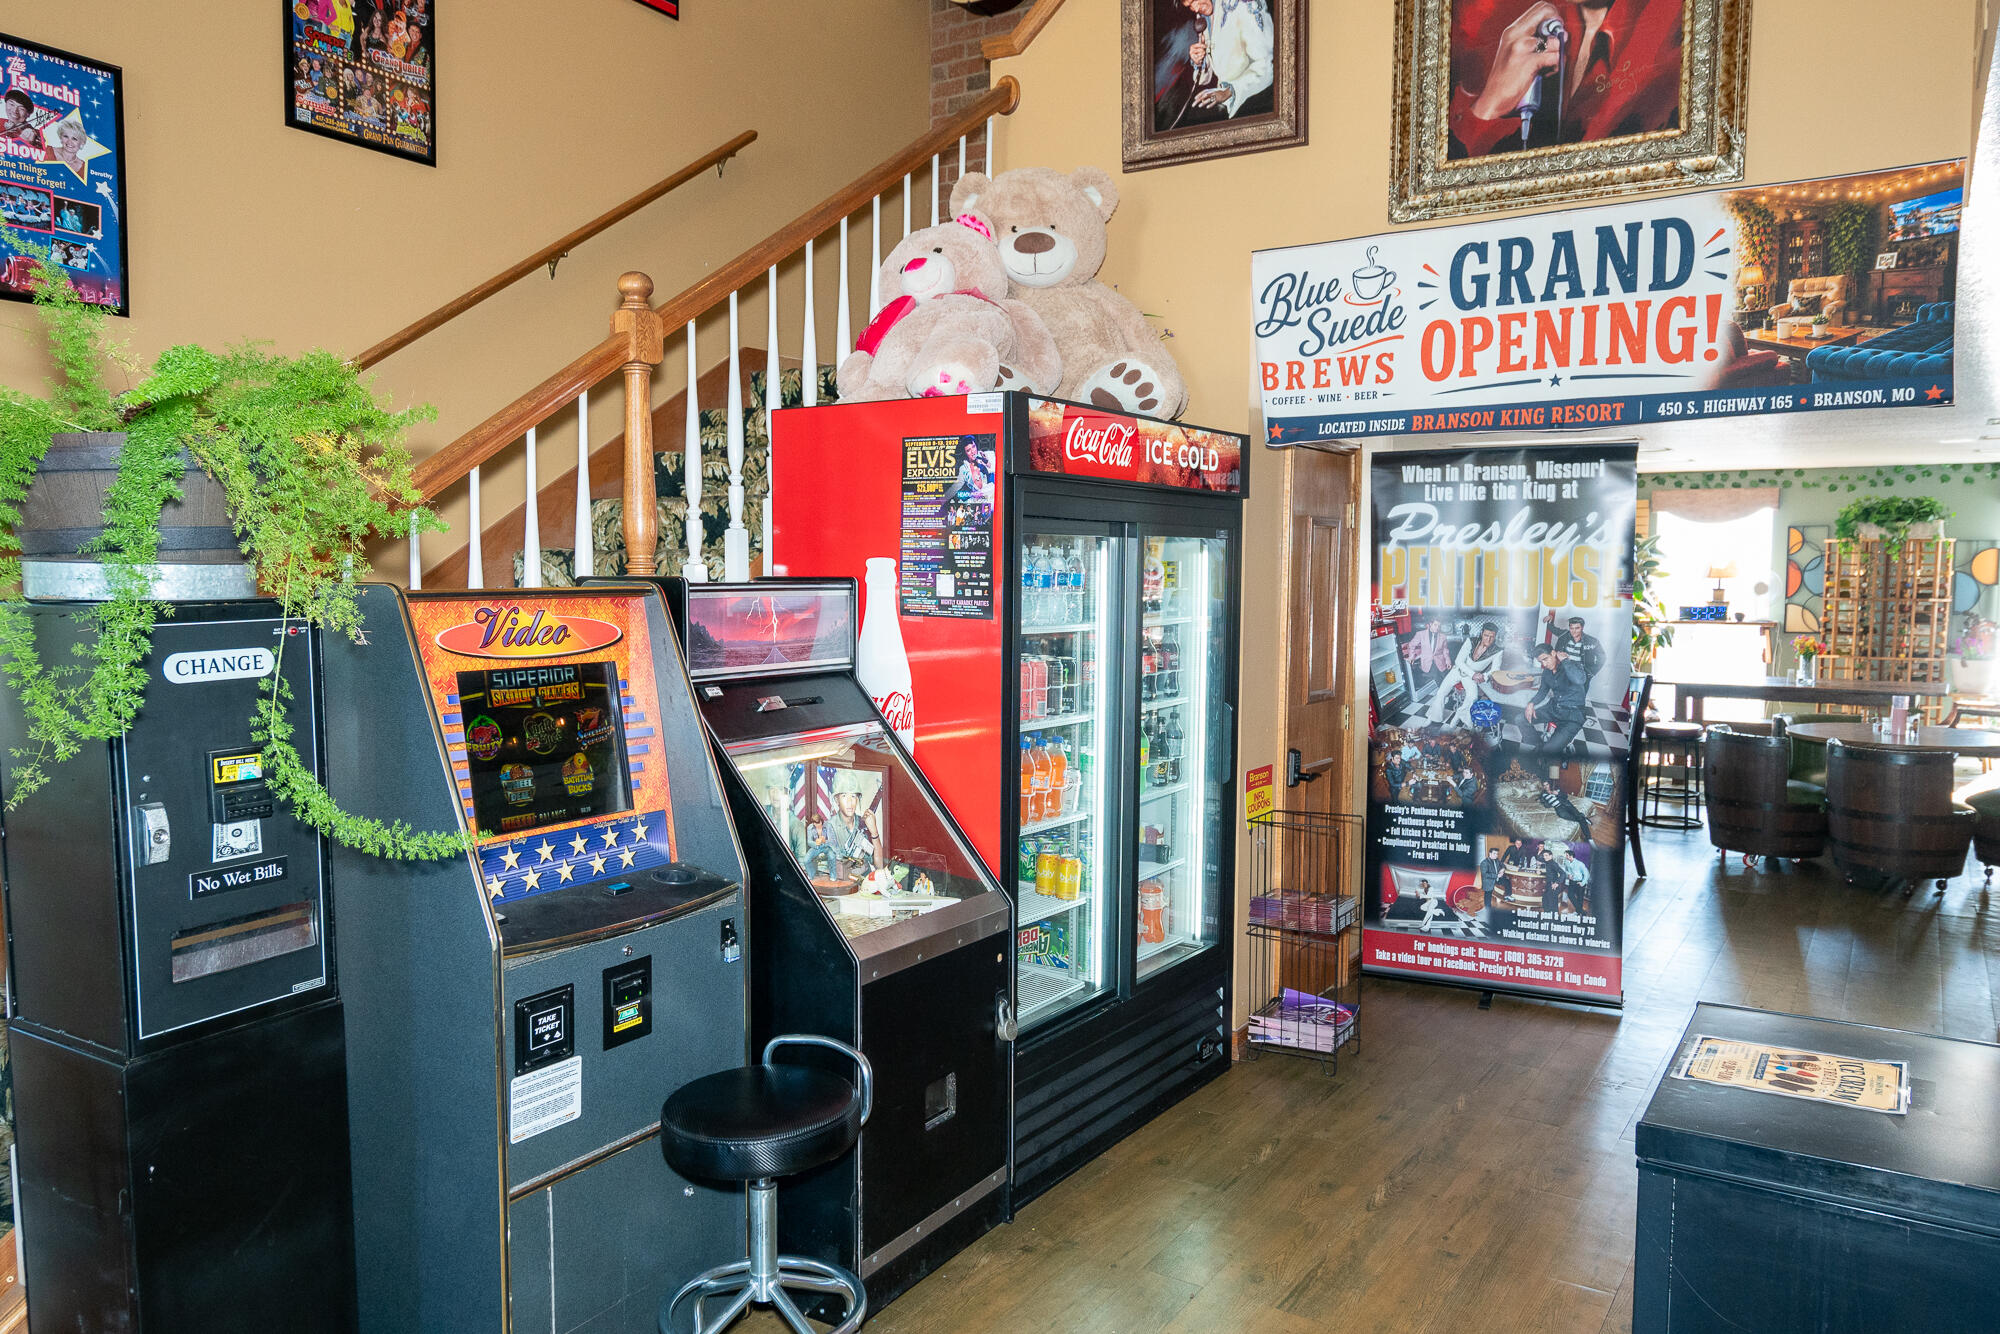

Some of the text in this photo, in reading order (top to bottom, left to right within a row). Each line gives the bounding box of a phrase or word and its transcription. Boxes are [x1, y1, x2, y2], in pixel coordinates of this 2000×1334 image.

[23, 50, 39, 59] FOR
[43, 55, 65, 66] OVER
[68, 61, 79, 70] 26
[397, 60, 426, 76] JUBILEE
[6, 70, 80, 107] Tabuchi
[0, 136, 46, 162] Show
[382, 132, 395, 146] FUN
[0, 159, 48, 176] ome Things
[89, 169, 113, 180] Dorothy
[9, 169, 35, 183] Never
[36, 174, 66, 190] Forget!
[1450, 217, 1695, 311] GRAND
[1256, 271, 1342, 338] Blue
[1299, 294, 1407, 357] Suede
[1420, 294, 1722, 382] OPENING!
[1261, 352, 1394, 391] BREWS
[1272, 391, 1378, 406] COFFEE WINE BEER
[1318, 387, 1916, 435] LOCATED INSIDE BRANSON KING RESORT 450 S. HIGHWAY 165 BRANSON, MO
[1065, 416, 1136, 467] Coca-Cola
[907, 449, 956, 468] ELVIS
[1145, 438, 1219, 471] ICE COLD
[907, 467, 956, 478] EXPLOSION
[1402, 458, 1606, 483] When in Branson, Missouri
[1424, 480, 1578, 502] Live like the King at
[1386, 502, 1618, 565] Presley's
[1381, 545, 1625, 609] PENTHOUSE
[474, 606, 570, 649] Video
[175, 654, 264, 676] CHANGE
[492, 667, 575, 688] SUPERIOR
[492, 683, 579, 706] SKILL GAMES
[1249, 770, 1270, 783] Branson
[567, 783, 593, 795] BUCKS
[1253, 790, 1265, 802] INFO
[1247, 797, 1271, 815] COUPONS
[1384, 804, 1464, 819] Presley's Penthouse features:
[1397, 816, 1425, 827] Penthouse
[1426, 818, 1444, 829] sleeps
[1390, 826, 1401, 836] Full
[1401, 827, 1421, 837] kitchen
[1427, 829, 1433, 838] 2
[1433, 829, 1462, 841] bathrooms
[1382, 836, 1471, 854] Complimentary breakfast in lobby
[1412, 850, 1425, 859] Free
[197, 863, 283, 893] No Wet Bills
[1517, 908, 1540, 919] Outdoor
[1540, 910, 1553, 920] pool
[1582, 915, 1597, 925] area
[1517, 919, 1539, 930] Located
[1540, 922, 1549, 931] off
[1550, 923, 1572, 933] famous
[1572, 925, 1586, 936] Hwy
[1413, 939, 1426, 952] For
[1427, 941, 1459, 957] bookings
[1460, 946, 1477, 958] call:
[1502, 928, 1525, 941] Walking
[1525, 931, 1550, 942] distance
[1550, 934, 1557, 943] to
[1558, 934, 1577, 945] shows
[1585, 937, 1611, 949] wineries
[1375, 948, 1607, 988] Take a video tour on FaceBook: Presley's Penthouse & King Condo
[534, 1020, 561, 1035] TICKET
[537, 1013, 557, 1025] TAKE
[1821, 1067, 1838, 1086] TREATS
[1829, 1061, 1866, 1102] ICE CREAM
